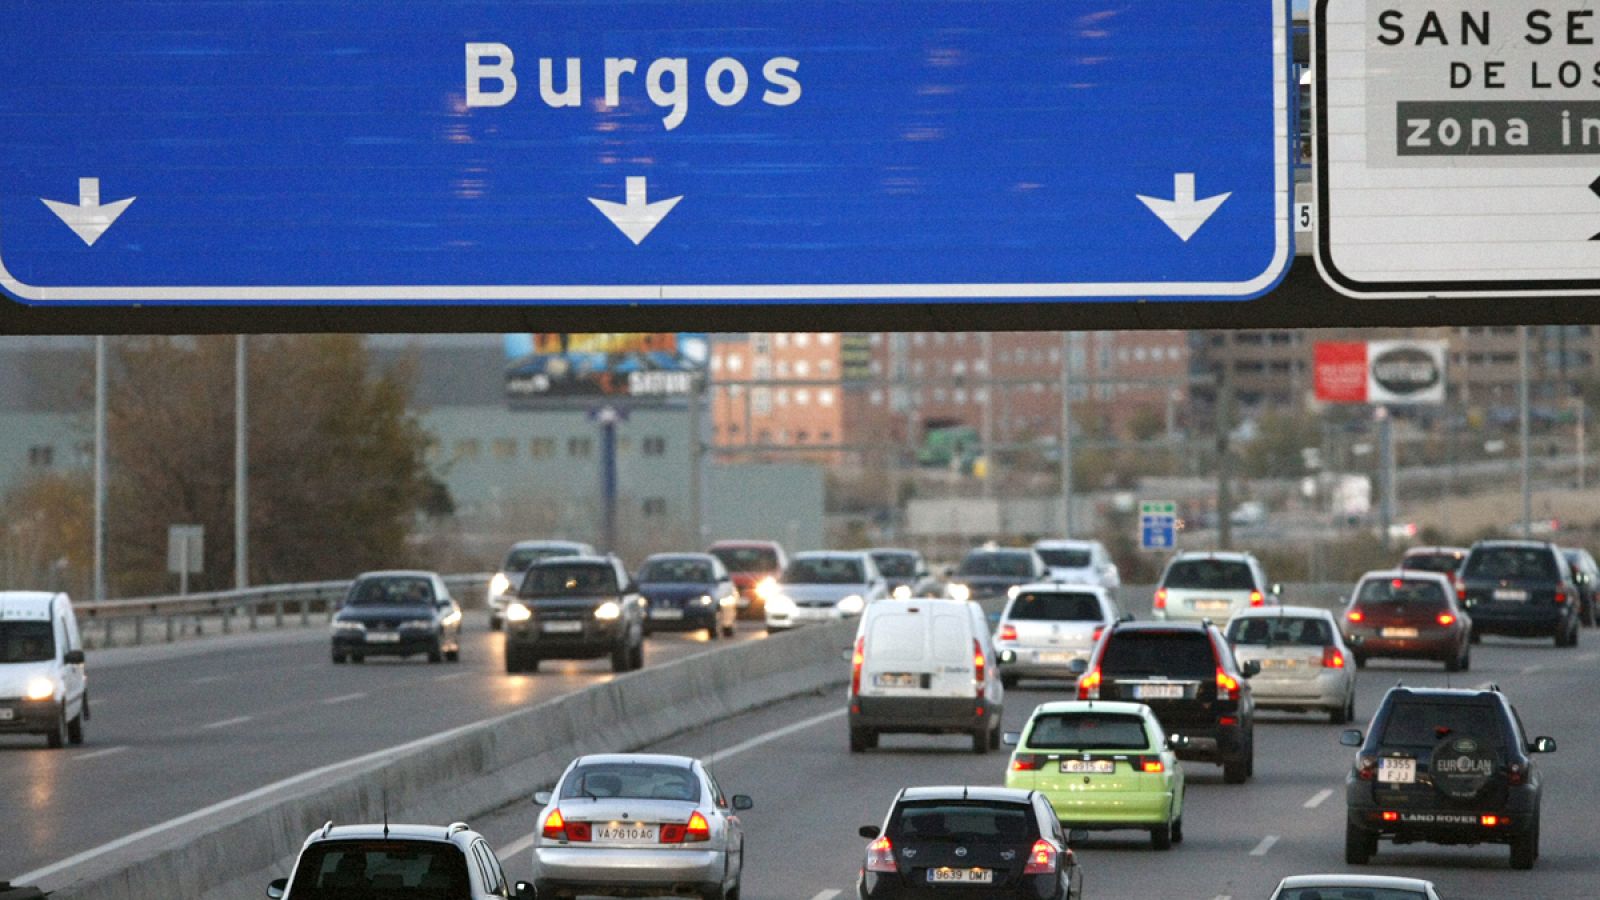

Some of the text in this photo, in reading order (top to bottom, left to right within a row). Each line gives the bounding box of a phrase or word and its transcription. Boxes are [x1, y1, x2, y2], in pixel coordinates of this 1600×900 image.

[1377, 9, 1594, 46] SAN SE
[1450, 61, 1505, 89] DE
[465, 42, 803, 131] Burgos
[1406, 110, 1600, 147] zona in
[1301, 206, 1310, 228] 5
[1386, 759, 1411, 769] 3355
[1400, 814, 1477, 824] LAND ROVER
[598, 829, 610, 839] VA
[612, 829, 638, 840] 7610
[936, 869, 962, 880] 9639
